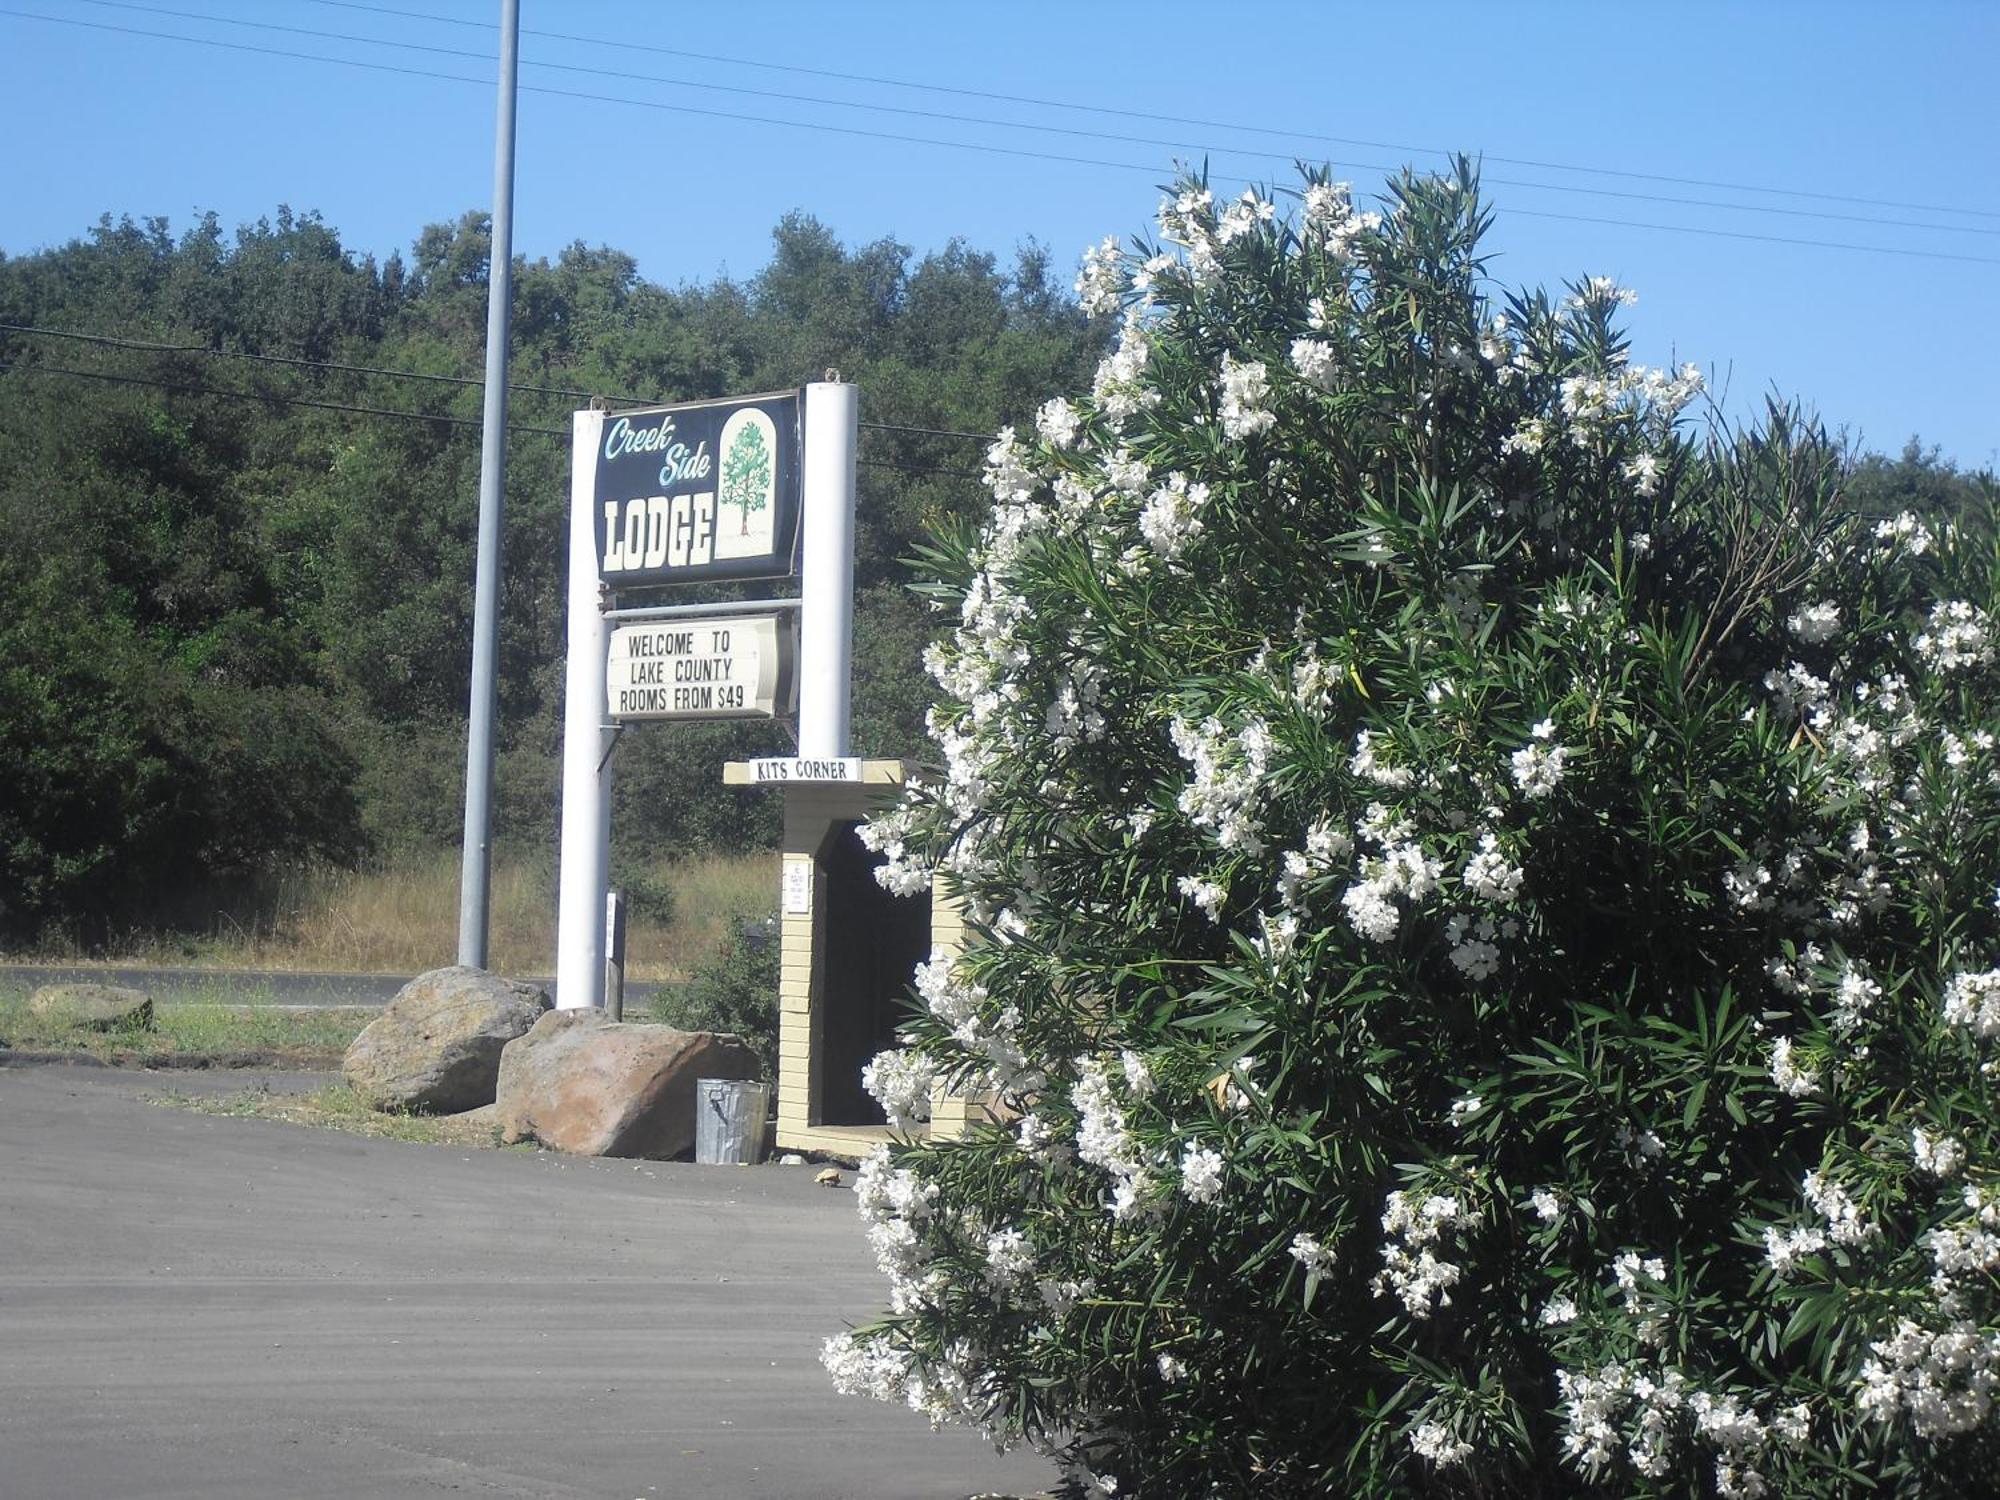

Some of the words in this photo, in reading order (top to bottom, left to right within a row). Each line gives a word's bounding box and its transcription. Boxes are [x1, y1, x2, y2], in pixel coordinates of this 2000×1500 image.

[605, 416, 675, 459] Creek
[659, 441, 710, 486] Side
[604, 492, 713, 571] LODGE
[629, 633, 693, 657] WELCOME
[713, 631, 730, 652] TO
[631, 662, 663, 684] LAKE
[675, 659, 732, 681] COUNTY
[620, 688, 666, 711] ROOMS
[675, 687, 712, 709] FROM
[718, 686, 743, 707] $49
[757, 762, 787, 779] KITS
[796, 761, 847, 779] CORNER
